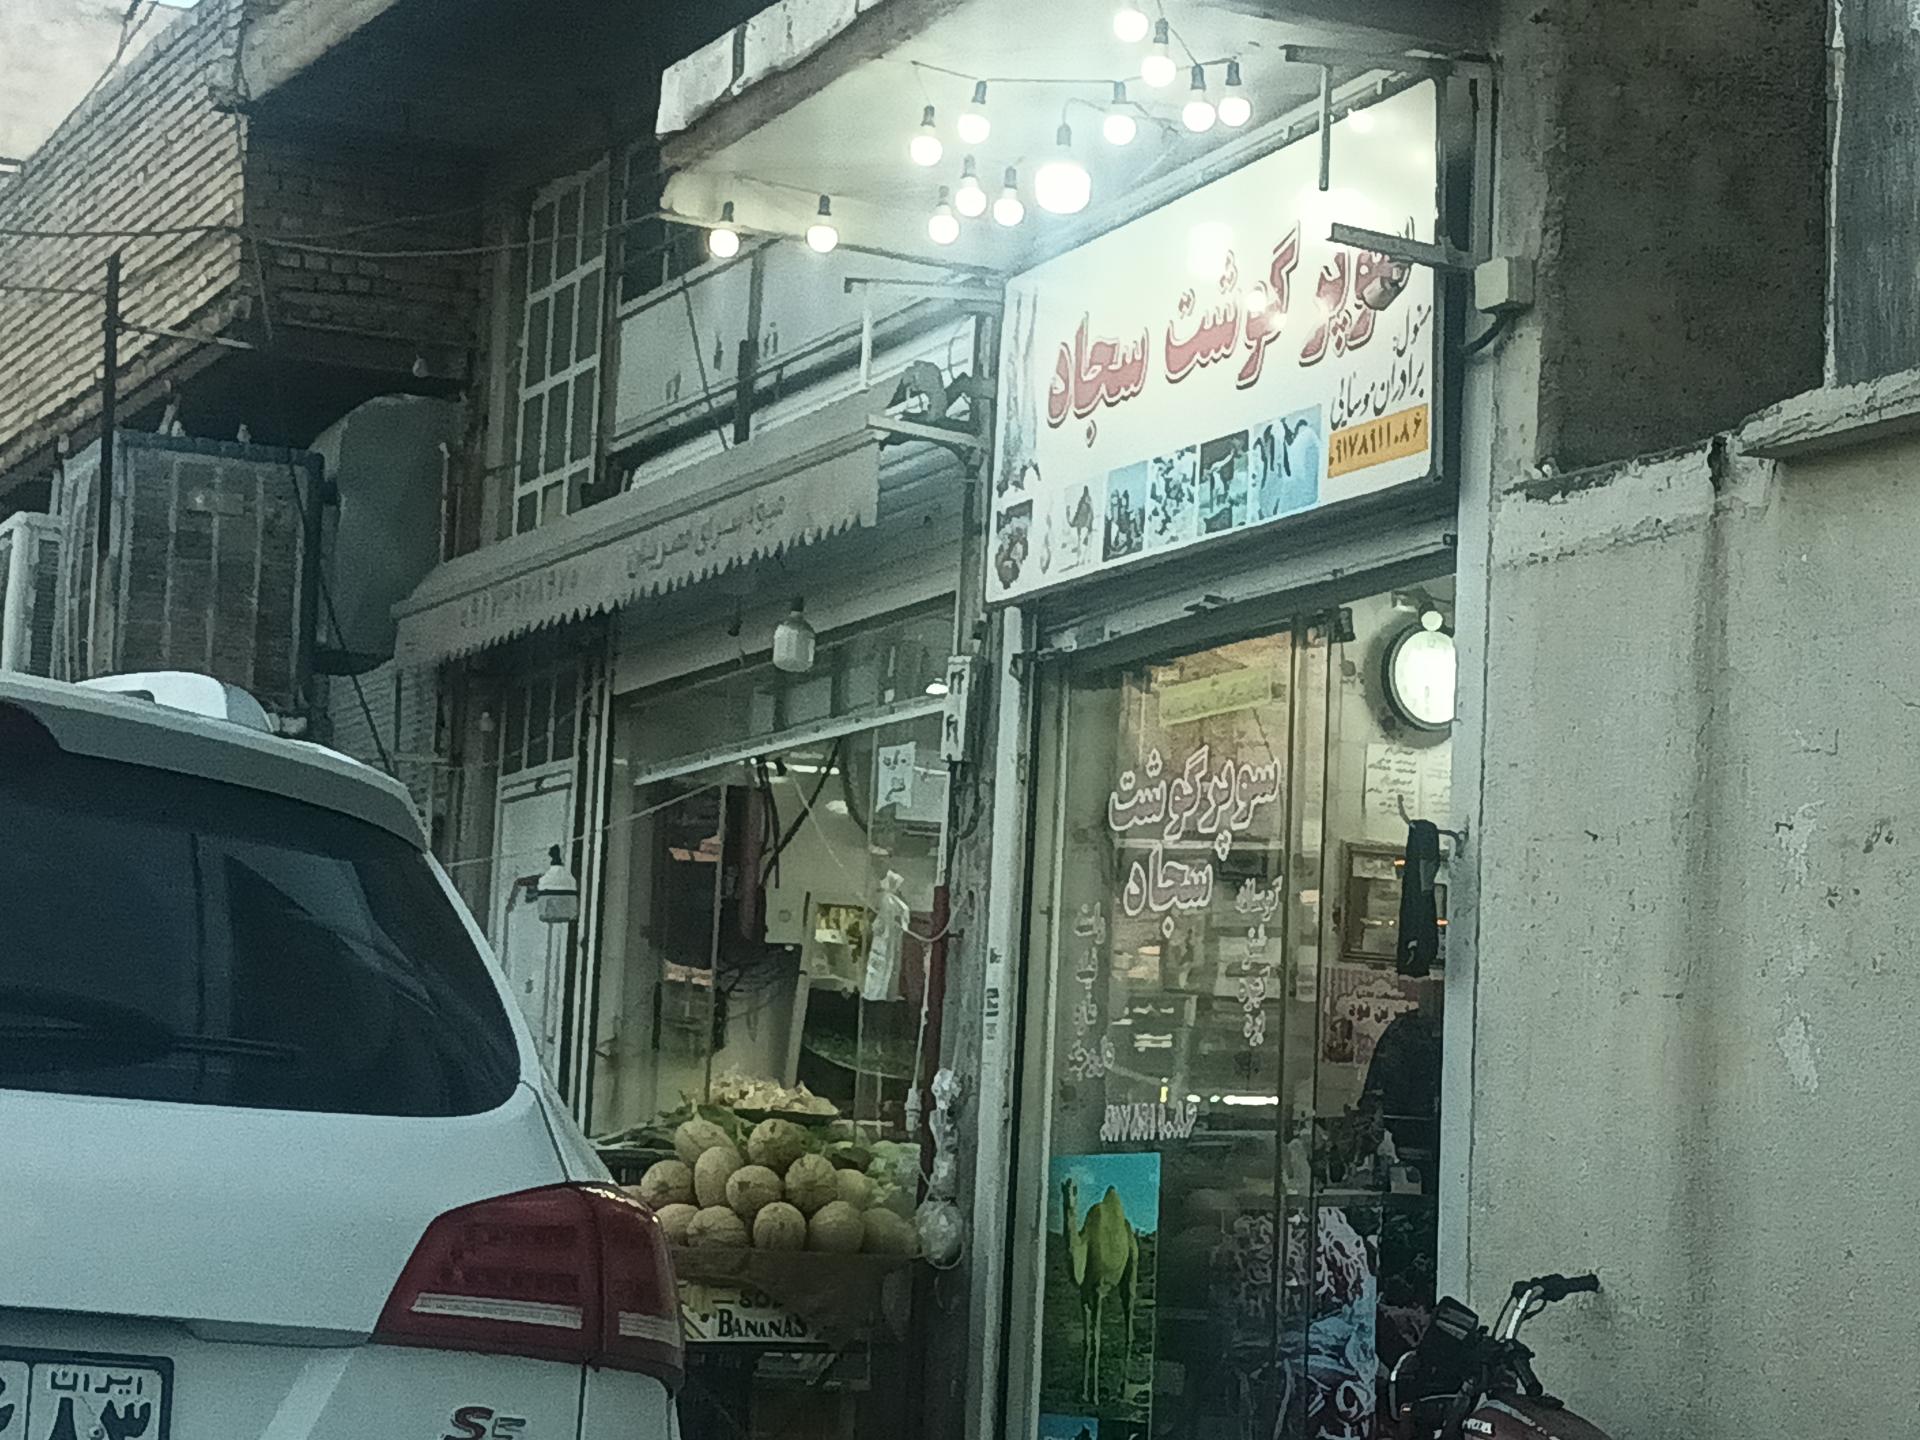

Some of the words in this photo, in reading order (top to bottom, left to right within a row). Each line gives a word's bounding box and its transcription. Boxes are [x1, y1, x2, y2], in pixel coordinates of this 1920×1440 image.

[1165, 220, 1300, 391] گوشت
[1047, 310, 1149, 449] سجاد
[1374, 353, 1425, 417] برادران
[1108, 744, 1210, 842] گوشت
[1198, 757, 1282, 862] سوپر
[1122, 840, 1214, 939] سجاد
[51, 1370, 143, 1395] ایران
